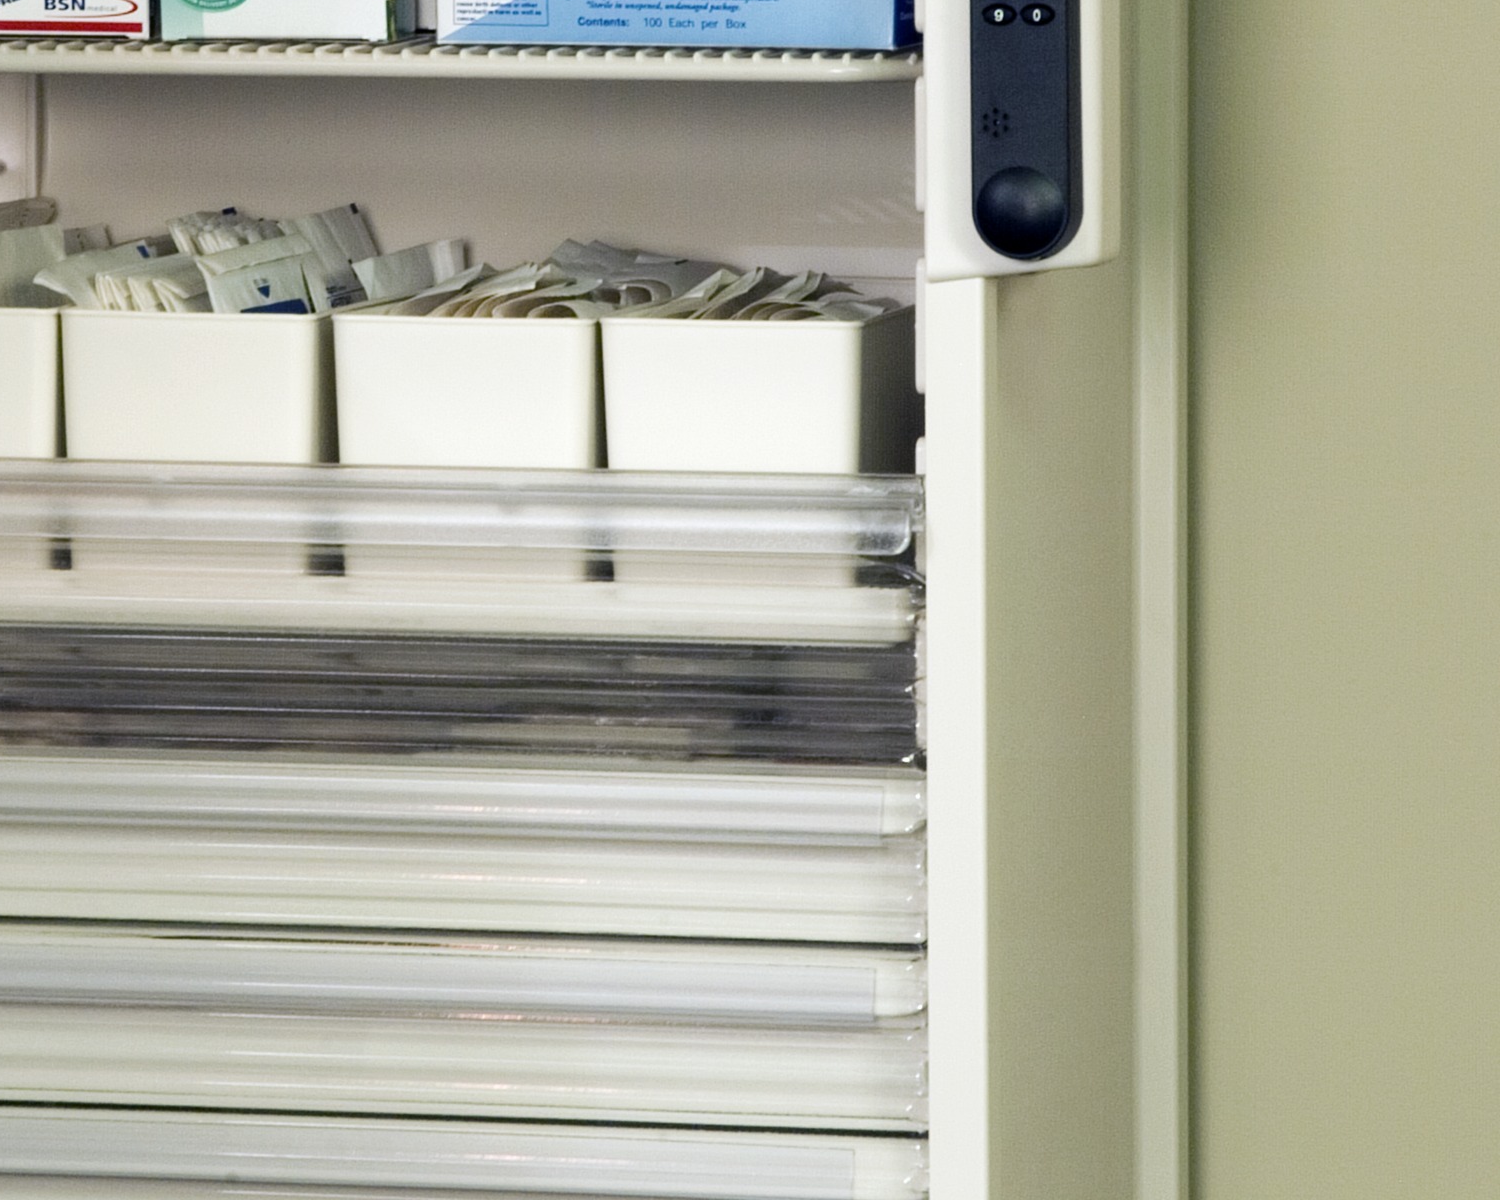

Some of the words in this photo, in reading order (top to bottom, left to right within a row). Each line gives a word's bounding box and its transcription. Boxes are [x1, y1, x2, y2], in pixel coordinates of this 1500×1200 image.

[993, 9, 1004, 22] 9
[1032, 9, 1041, 22] 0
[578, 17, 630, 27] Contents:
[644, 18, 662, 27] 100
[669, 18, 695, 29] Each
[701, 20, 718, 31] per
[726, 19, 746, 29] Box
